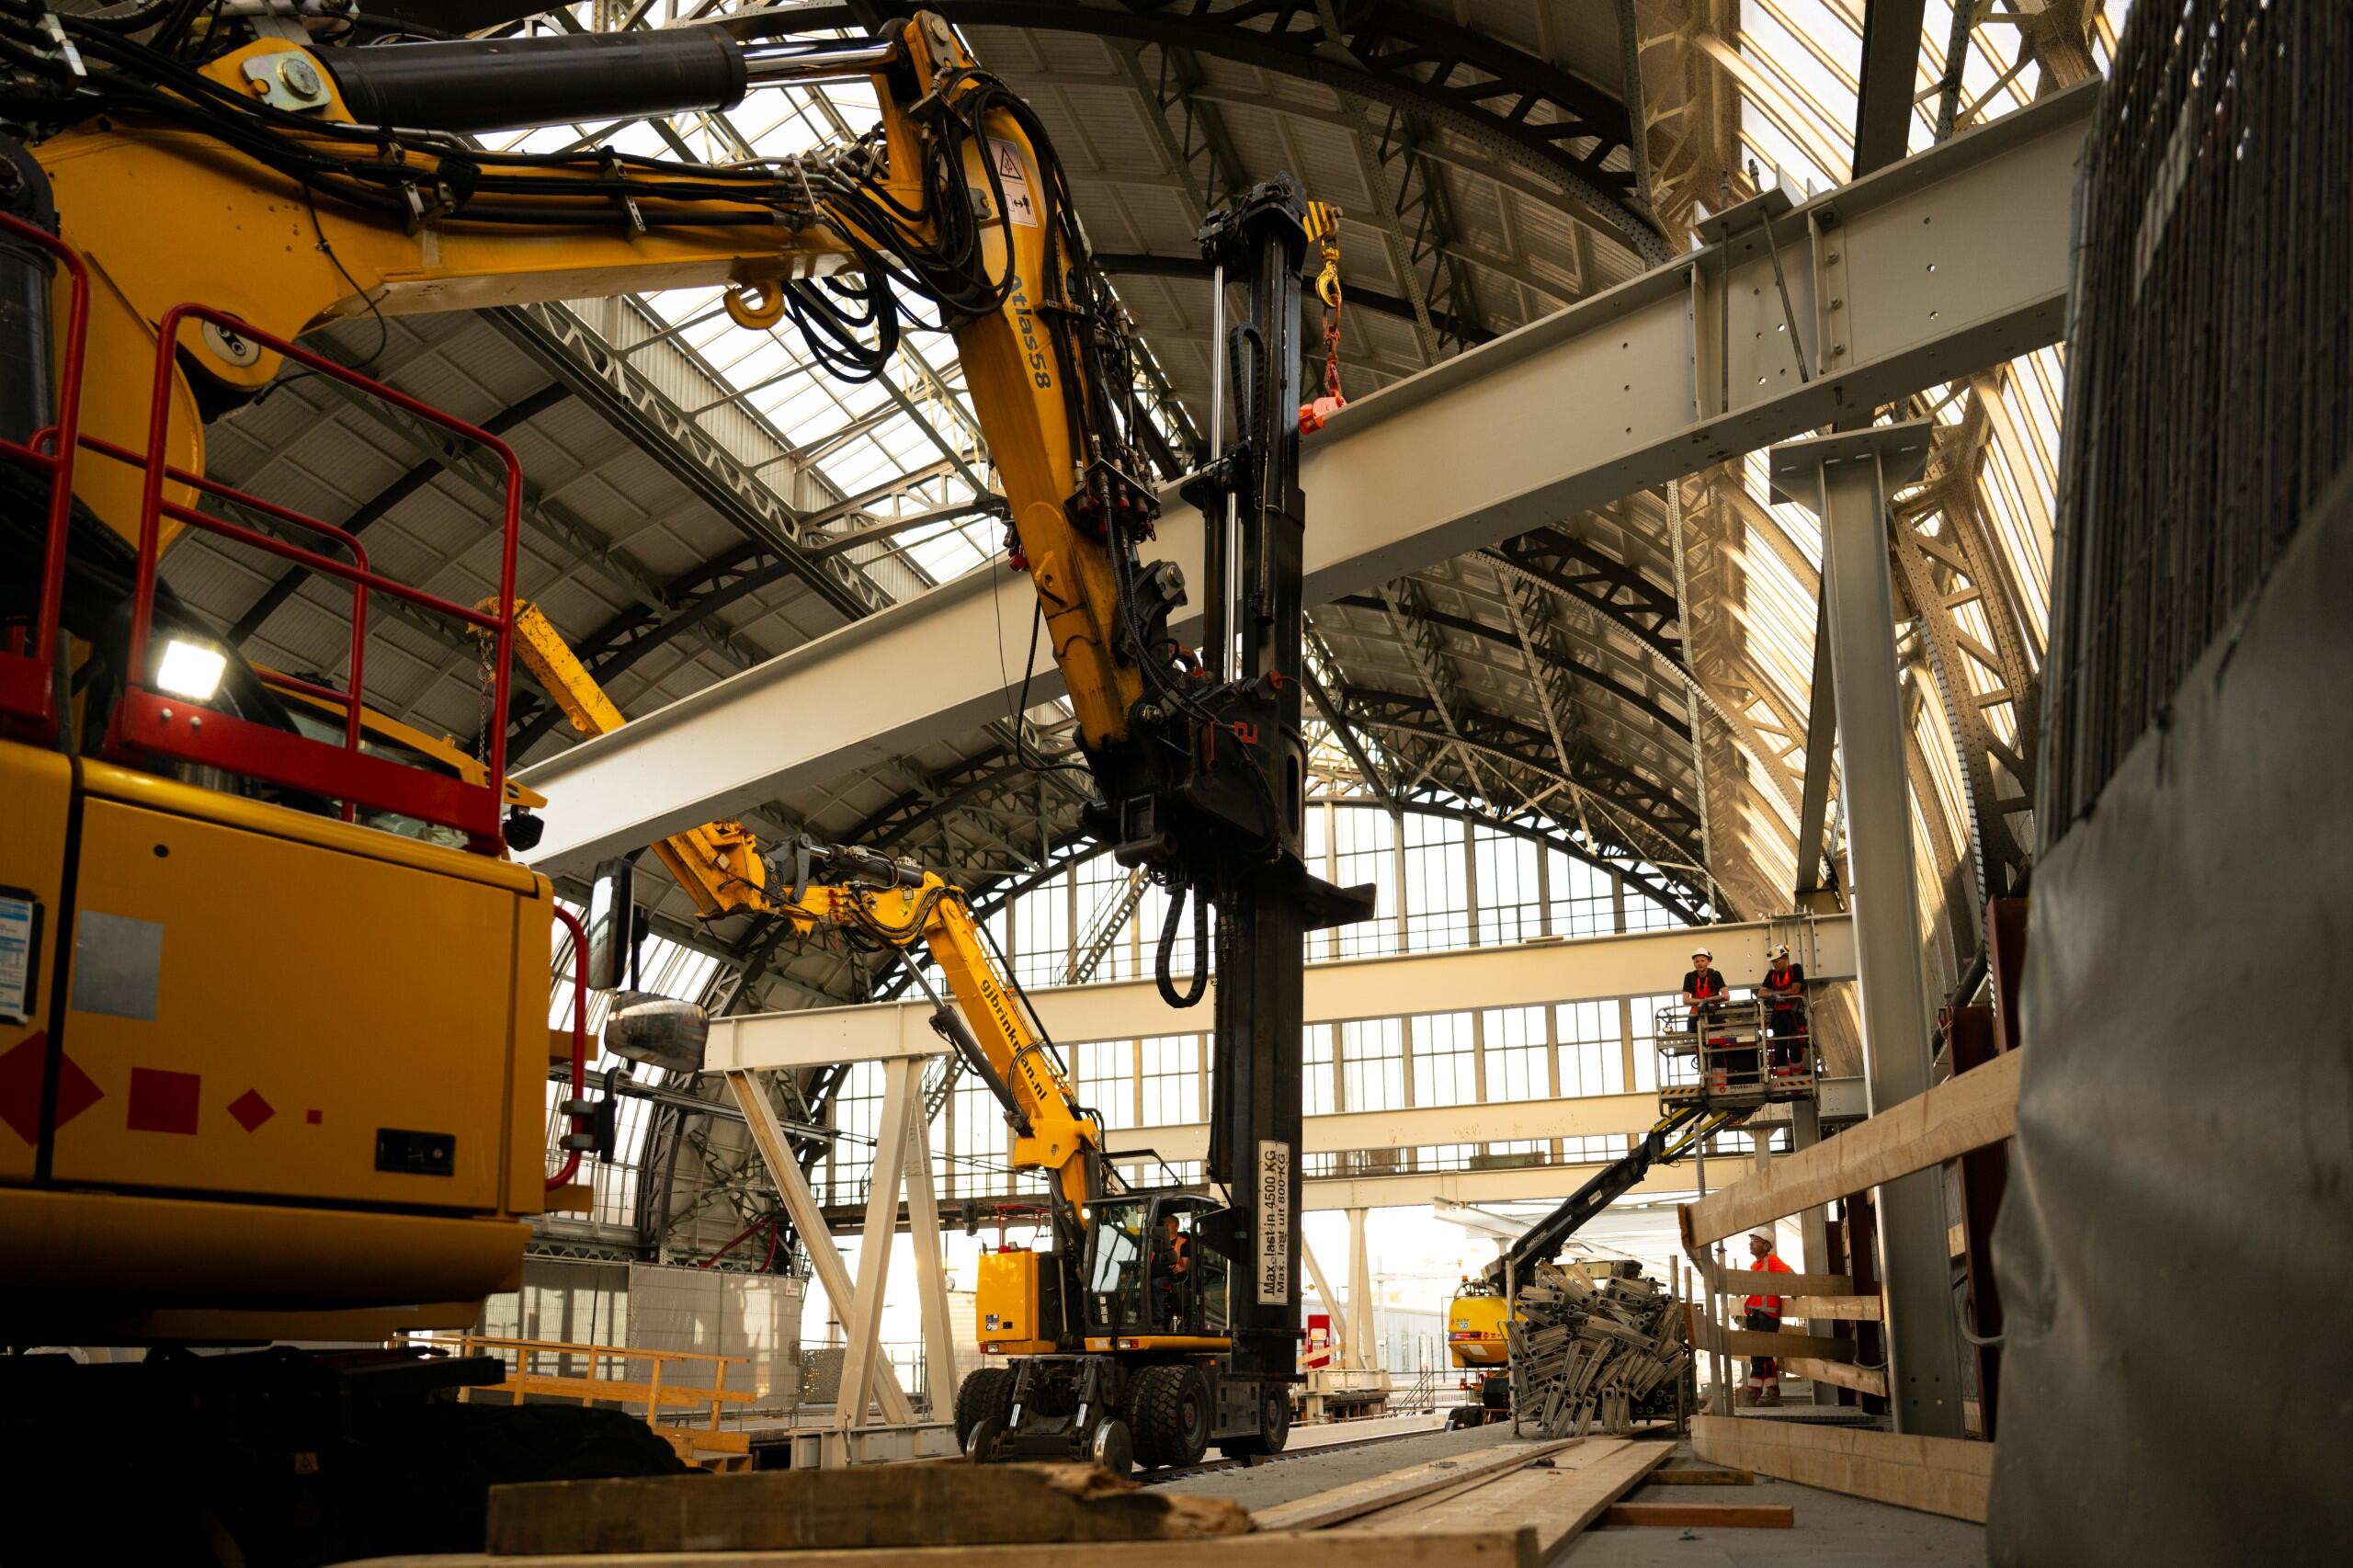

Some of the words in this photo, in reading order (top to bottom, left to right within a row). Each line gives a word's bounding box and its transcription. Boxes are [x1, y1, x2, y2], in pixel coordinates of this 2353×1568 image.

[980, 979, 1048, 1101] gjbrinkman.nl
[1265, 1150, 1277, 1172] KG
[1278, 1153, 1286, 1175] KG
[1264, 1176, 1276, 1210] 4500
[1278, 1179, 1286, 1203] 800
[1264, 1213, 1276, 1227] in
[1277, 1208, 1285, 1226] uit
[1264, 1231, 1276, 1256] last
[1277, 1231, 1285, 1256] last
[1264, 1261, 1276, 1295] Max.
[1277, 1260, 1285, 1293] Max.
